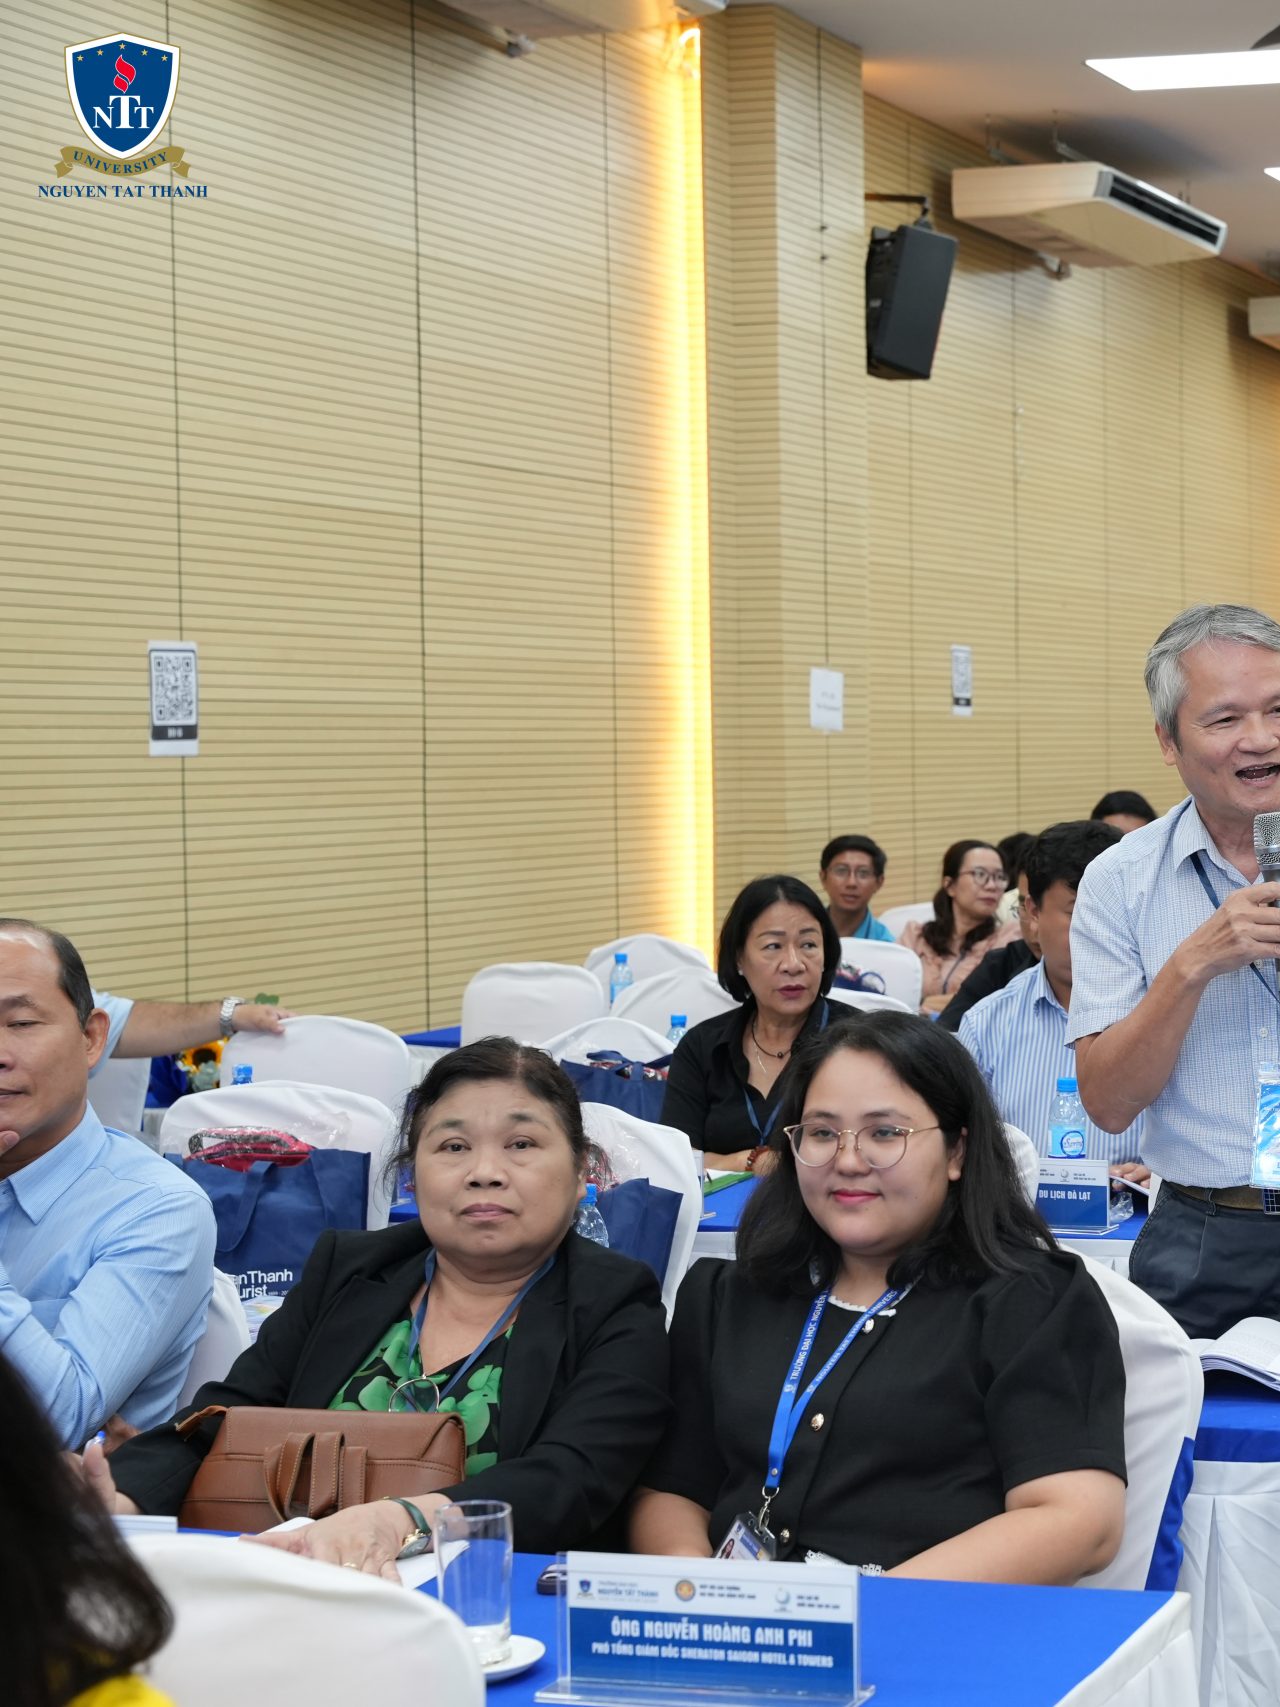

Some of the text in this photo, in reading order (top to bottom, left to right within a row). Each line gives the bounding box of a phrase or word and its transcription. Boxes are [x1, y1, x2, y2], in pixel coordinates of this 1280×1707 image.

[611, 1615, 813, 1648] ÔNG NGUYỄN HOÀNG ANH PHI
[761, 1651, 787, 1666] HOTEL
[797, 1654, 834, 1668] TOWERS
